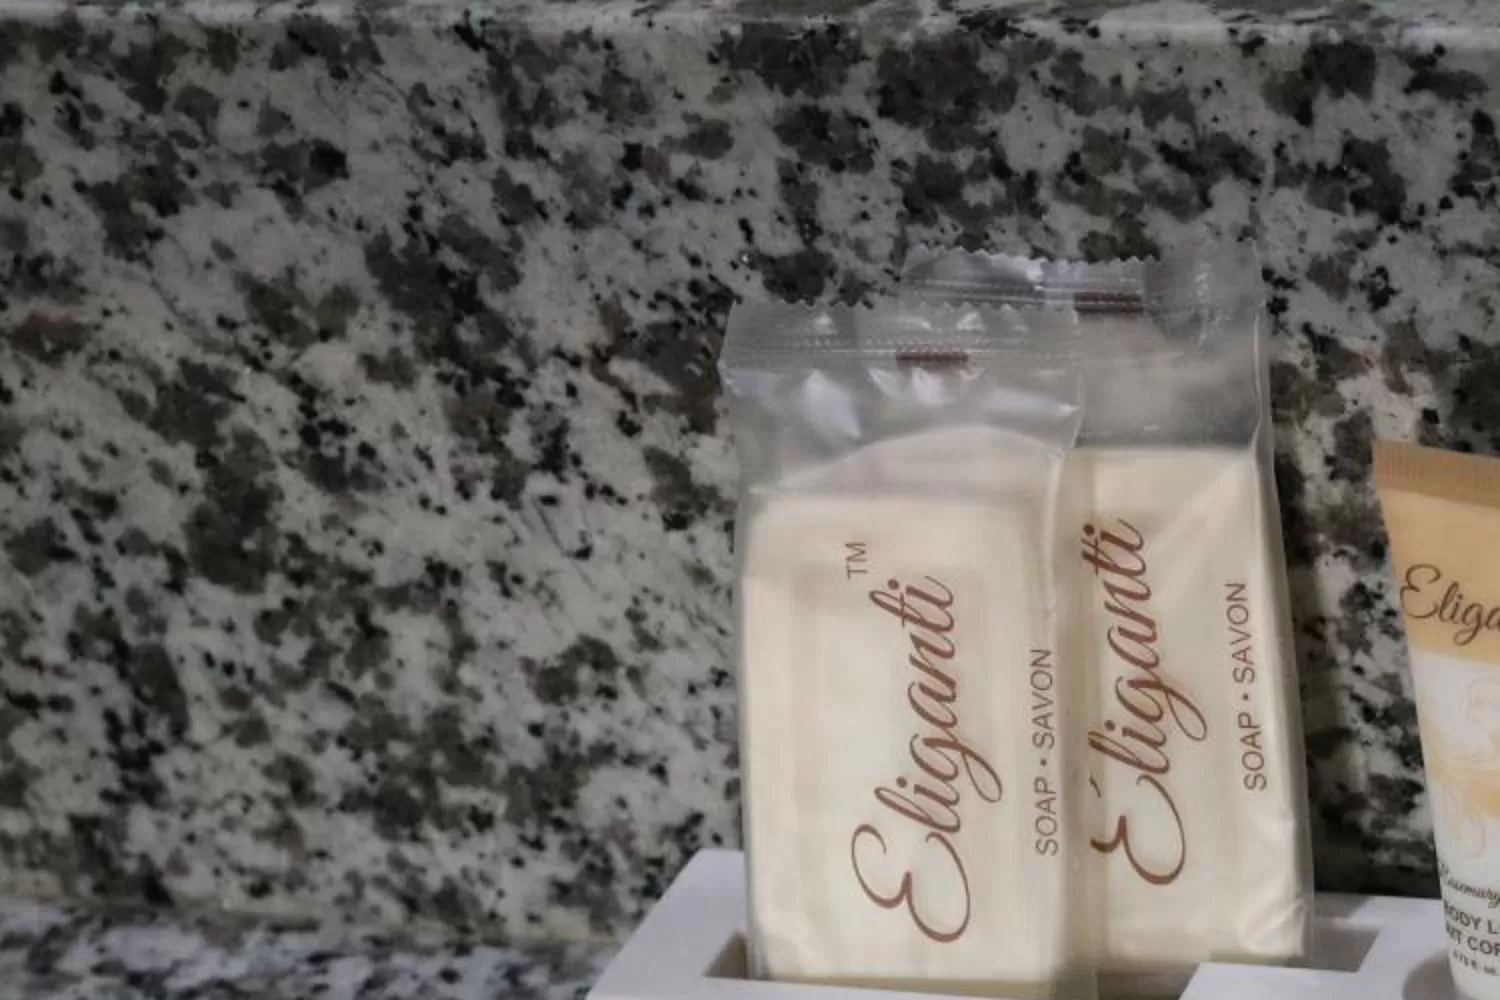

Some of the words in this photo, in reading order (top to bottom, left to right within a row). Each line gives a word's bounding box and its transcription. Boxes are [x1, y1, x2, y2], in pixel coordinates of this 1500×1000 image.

[1224, 582, 1256, 684] SAVON
[1030, 648, 1055, 750] SAVON
[851, 574, 1003, 943] Eliganti
[1238, 711, 1268, 791] SOAP
[1035, 776, 1060, 857] SOAP
